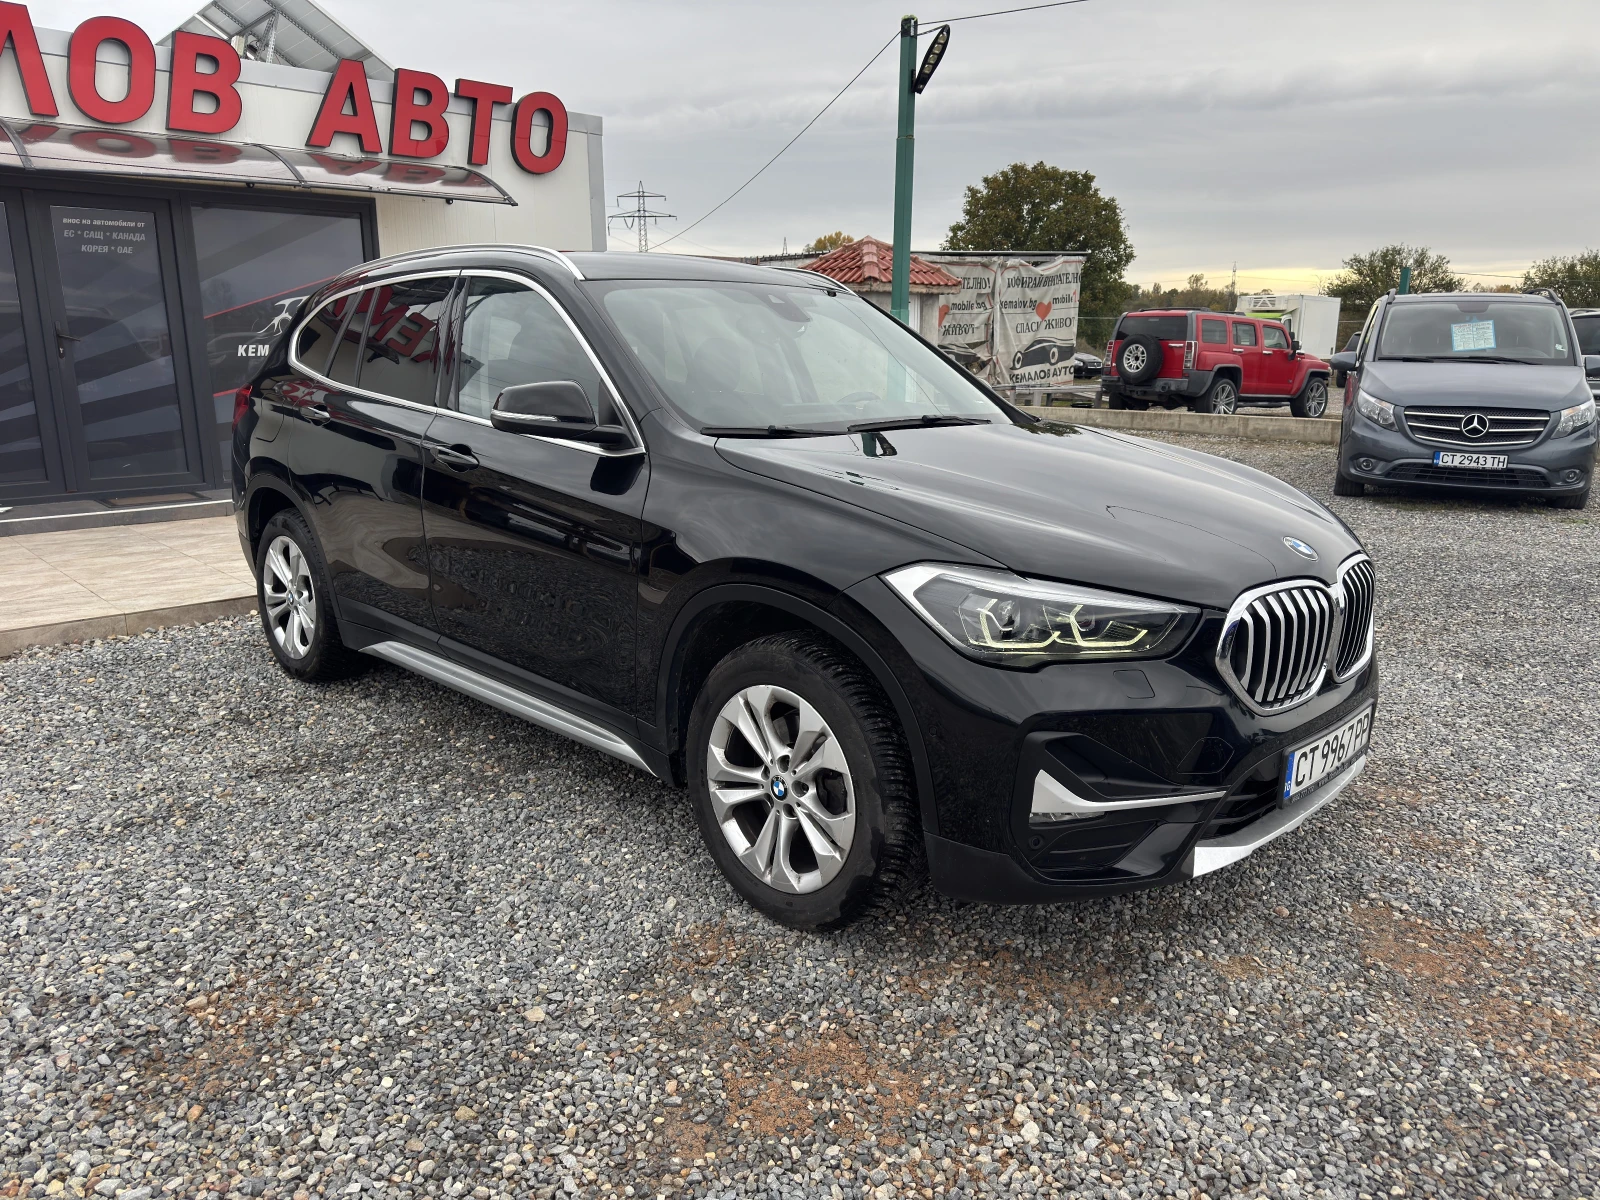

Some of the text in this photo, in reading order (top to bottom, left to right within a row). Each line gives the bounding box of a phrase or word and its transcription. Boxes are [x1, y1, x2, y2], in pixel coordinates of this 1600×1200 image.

[305, 58, 568, 174] АВТО
[93, 219, 135, 227] автомобили
[84, 231, 103, 240] САЩ
[112, 232, 146, 241] КАНАДА
[81, 244, 108, 253] КОРЕЯ
[958, 277, 991, 290] ТЕЛНО!
[1009, 365, 1074, 383] КЕМАЛОВ АУТО
[1442, 454, 1457, 464] CT
[1459, 455, 1488, 466] 2943
[1491, 456, 1506, 467] TH
[1296, 744, 1319, 786] CT
[1321, 723, 1354, 774] 9967
[1353, 712, 1369, 752] PP
